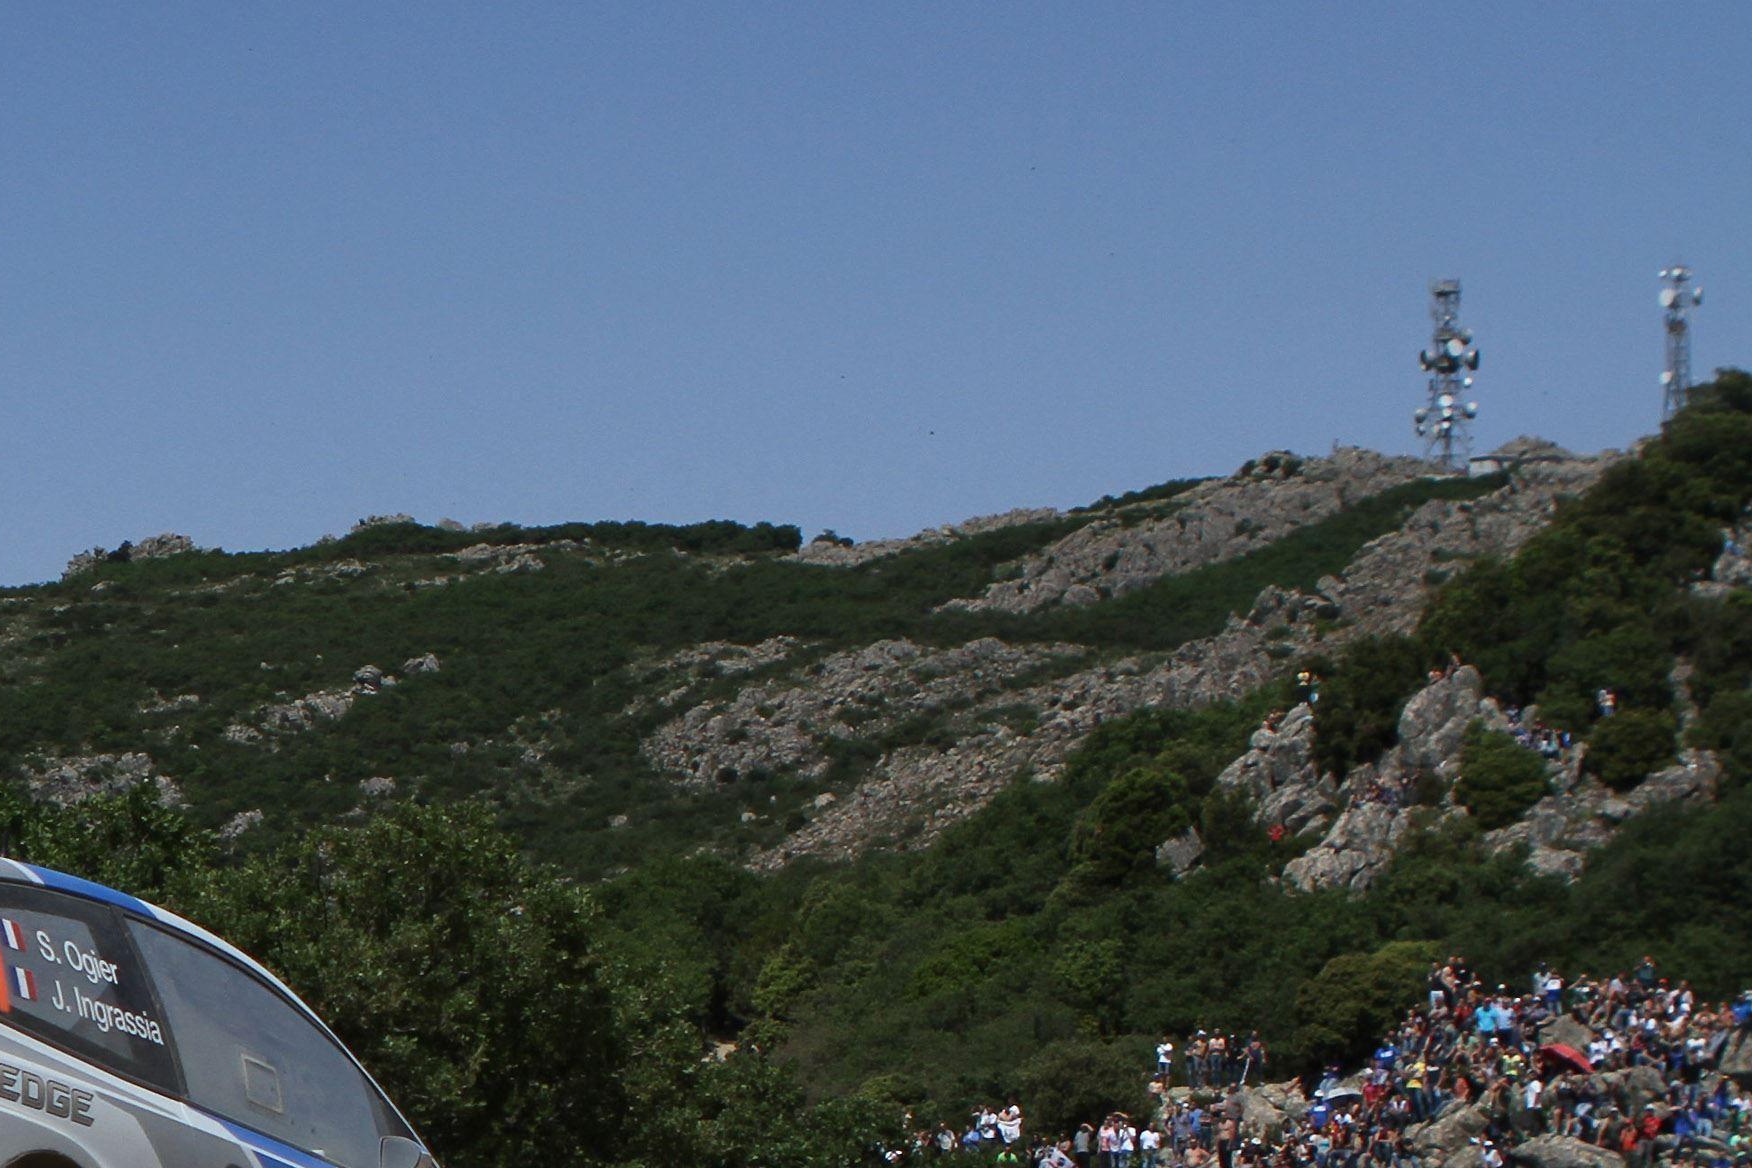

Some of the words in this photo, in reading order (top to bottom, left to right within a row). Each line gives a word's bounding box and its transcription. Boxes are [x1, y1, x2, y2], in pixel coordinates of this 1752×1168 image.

[36, 930, 62, 965] S.
[64, 940, 118, 985] Ogier
[51, 980, 72, 1013] J.
[75, 985, 165, 1046] Ingrassia
